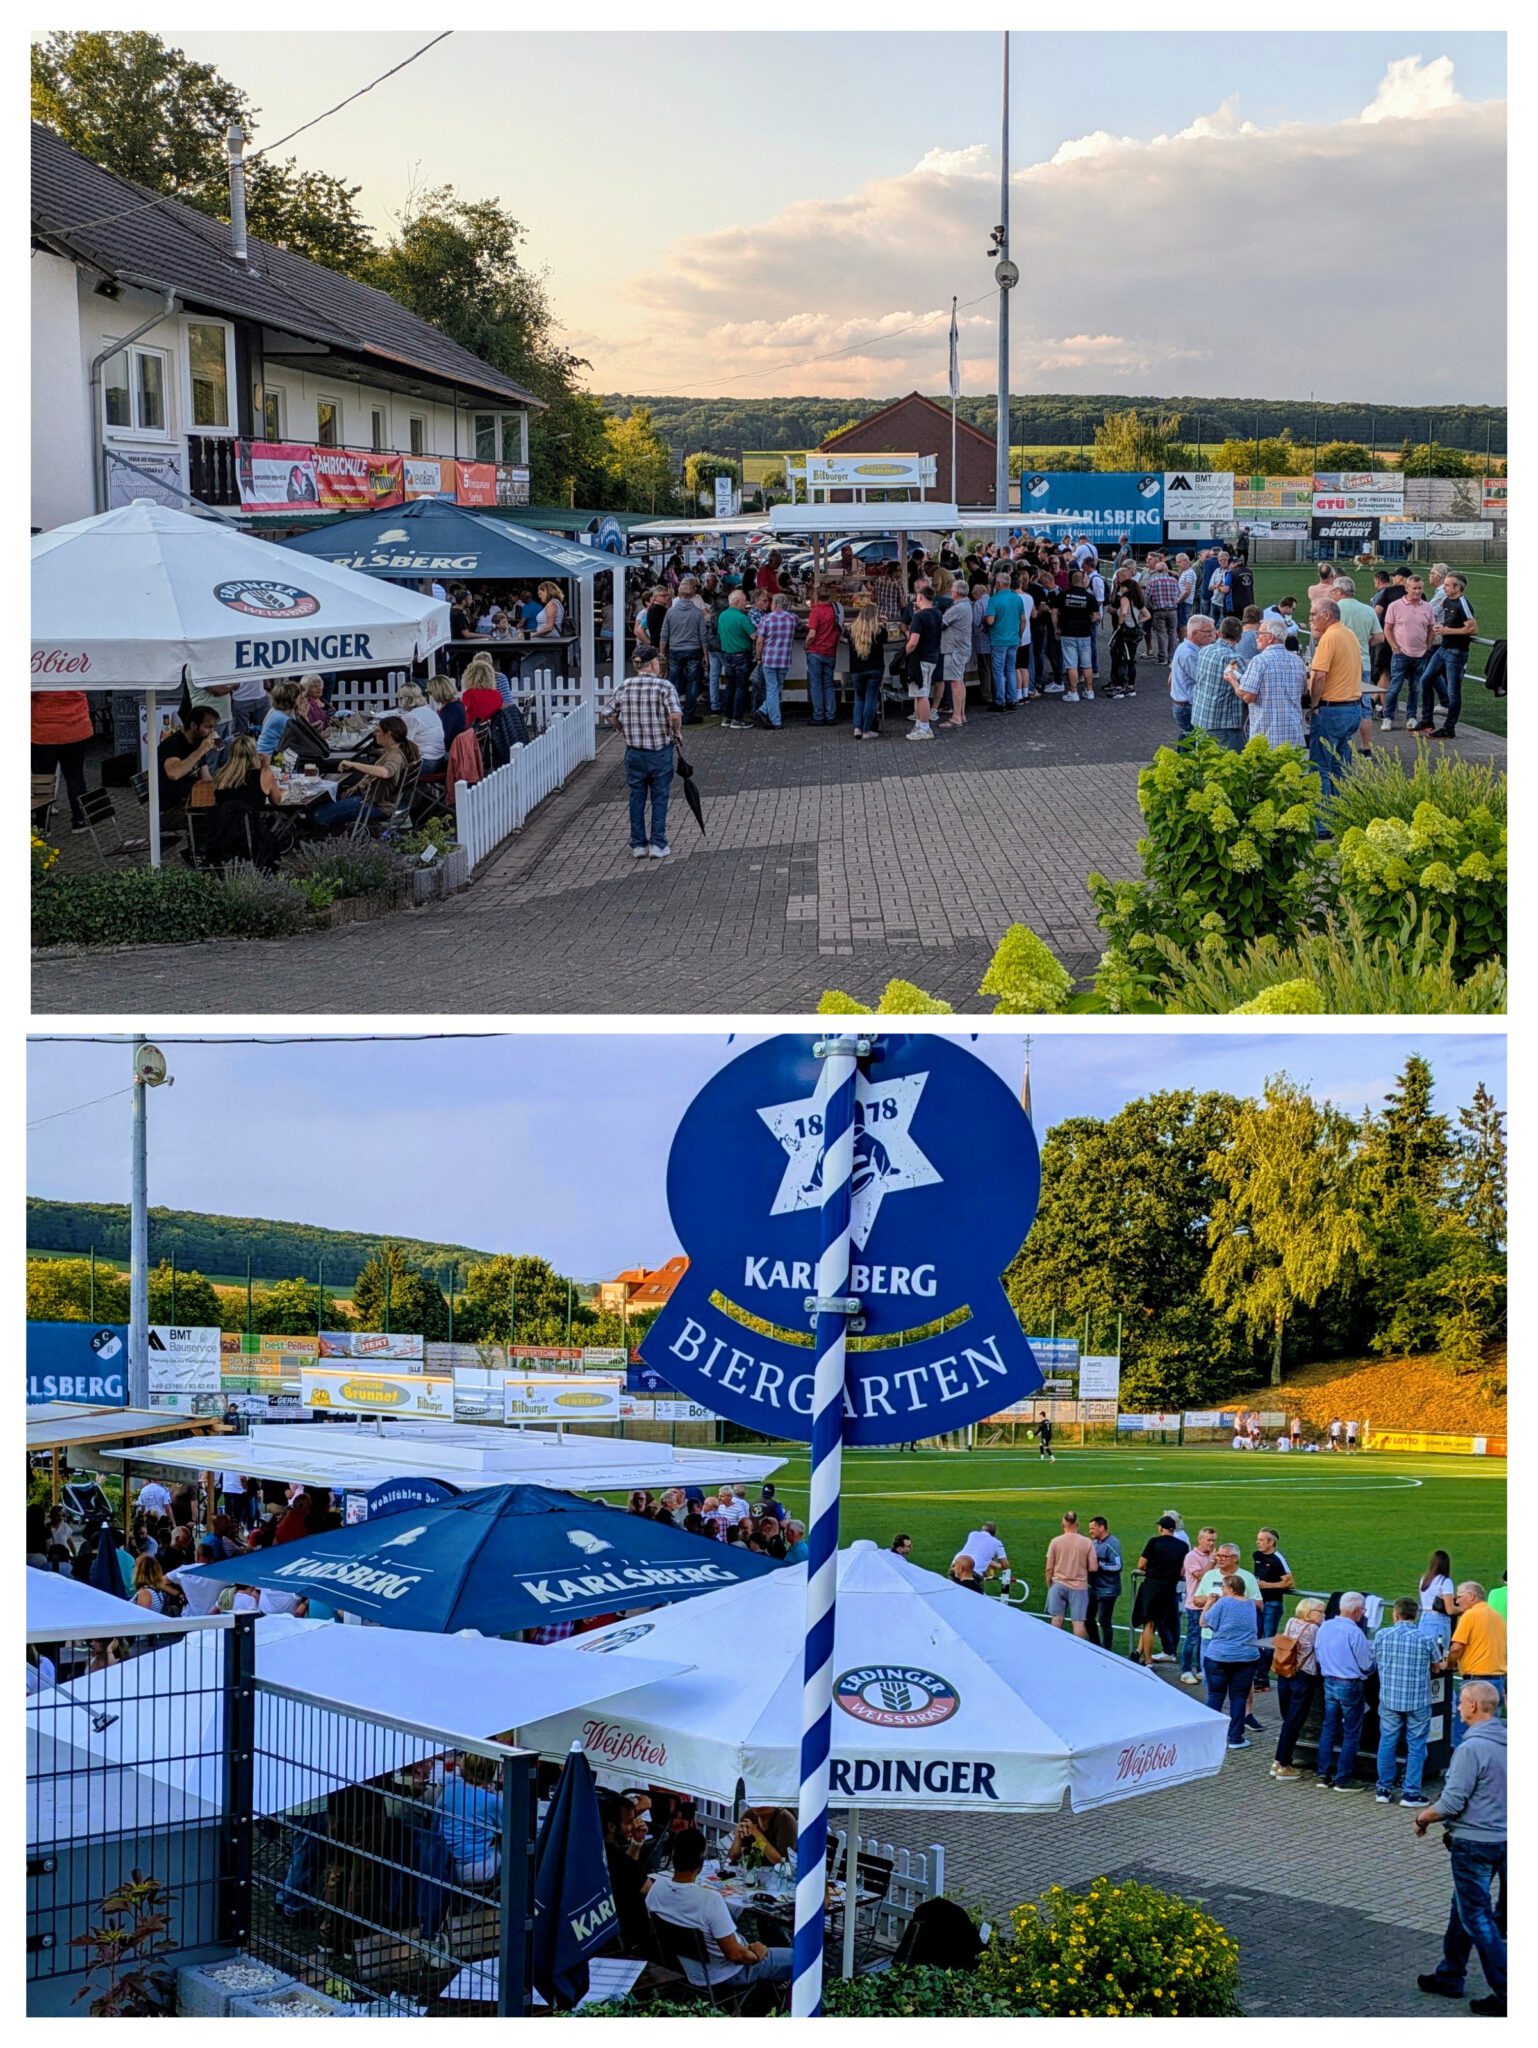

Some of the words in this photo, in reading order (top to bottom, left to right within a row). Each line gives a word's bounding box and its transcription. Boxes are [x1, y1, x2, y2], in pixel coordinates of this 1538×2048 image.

[312, 454, 368, 477] FAHRSCHULE
[813, 469, 849, 482] Bitburger
[1195, 474, 1212, 483] BMT
[1316, 498, 1345, 509] GTÜ
[1319, 527, 1372, 537] DECKERT
[333, 553, 479, 570] RLSBERG
[220, 581, 300, 600] ERDINGER
[31, 649, 92, 674] ßbier
[234, 633, 374, 670] ERDINGER
[744, 1255, 937, 1297] KARBERG
[170, 1329, 192, 1340] BMT
[169, 1342, 217, 1353] Bauservice
[27, 1375, 123, 1398] LSBERG
[511, 1400, 549, 1415] Bitburger
[1088, 1403, 1116, 1413] FAME
[1393, 1436, 1419, 1445] LOTTO
[370, 1488, 422, 1512] Wohlfühlen
[274, 1557, 421, 1600] KARLSBERG
[521, 1564, 739, 1604] KARLSBERG
[840, 1668, 946, 1694] ERDINGER
[852, 1703, 949, 1724] WEISSBRÄU
[582, 1720, 668, 1767] Weißbier
[1116, 1743, 1178, 1784] Weißbier
[828, 1759, 1000, 1800] RDINGER
